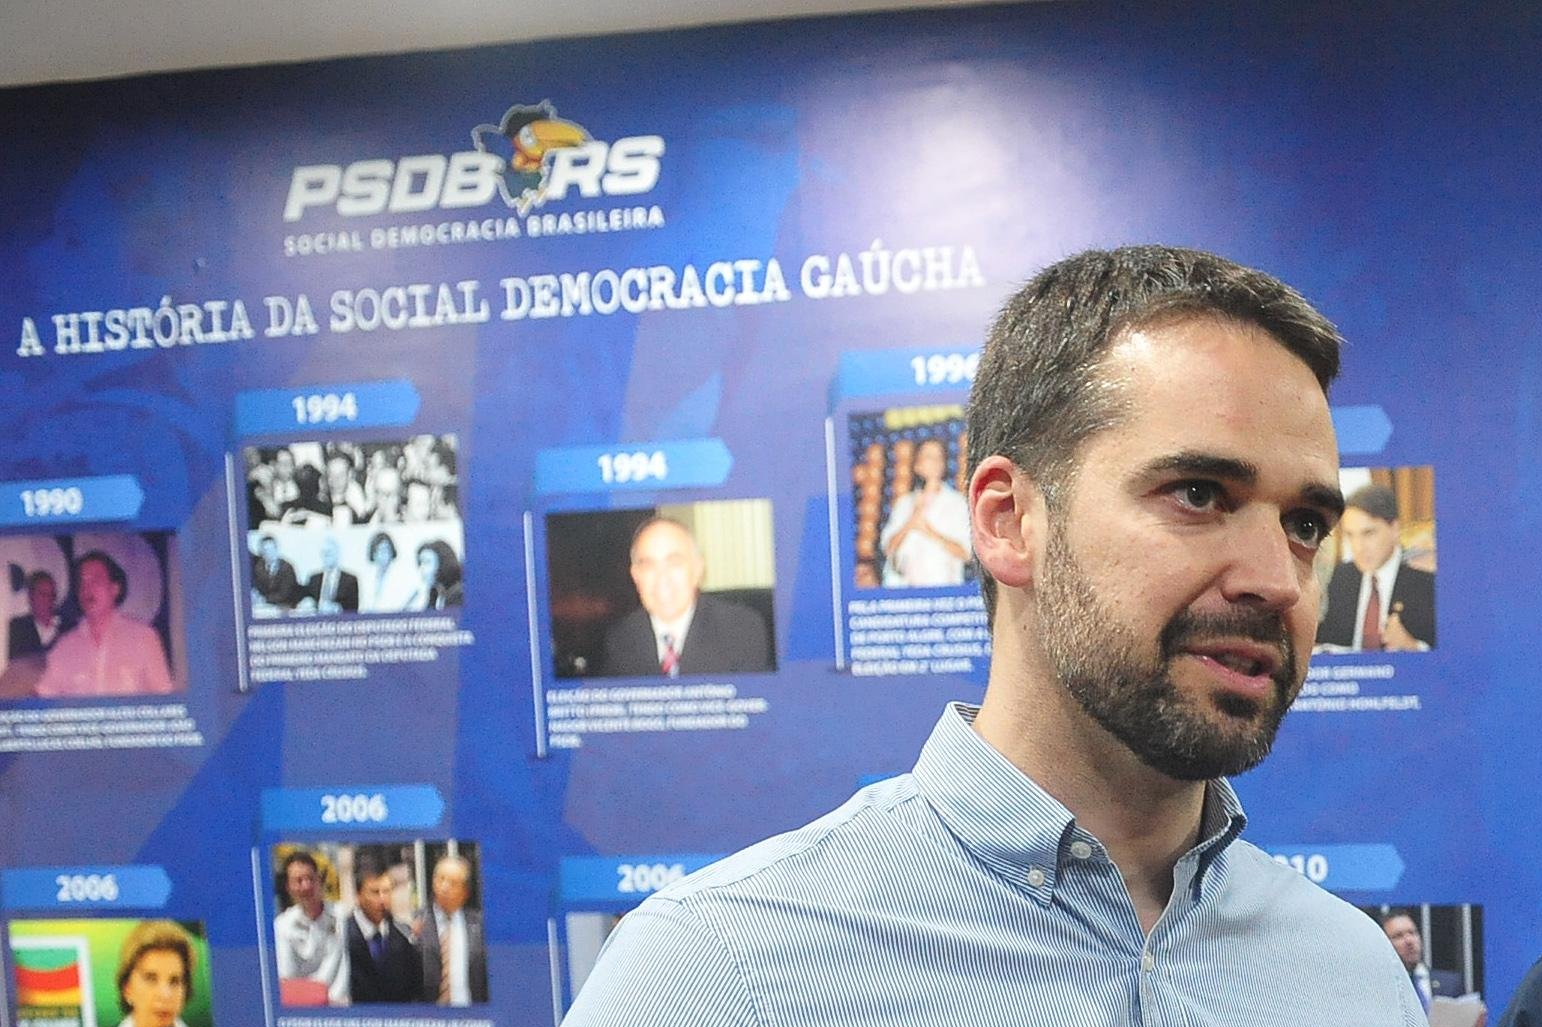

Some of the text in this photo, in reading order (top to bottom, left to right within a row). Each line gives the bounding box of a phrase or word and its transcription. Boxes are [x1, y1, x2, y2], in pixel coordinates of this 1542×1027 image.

[283, 134, 665, 222] PSDB RS
[283, 205, 665, 257] SOCIAL DEMOCRACIA BRASILEIRA
[16, 238, 988, 357] A HISTÓRIA DA SOCIAL DEMOCRACIA GAÚCHA
[291, 395, 358, 423] 1994
[598, 450, 668, 483] 1994
[19, 487, 84, 517] 1990
[321, 793, 388, 823] 2006
[55, 874, 119, 902] 2006
